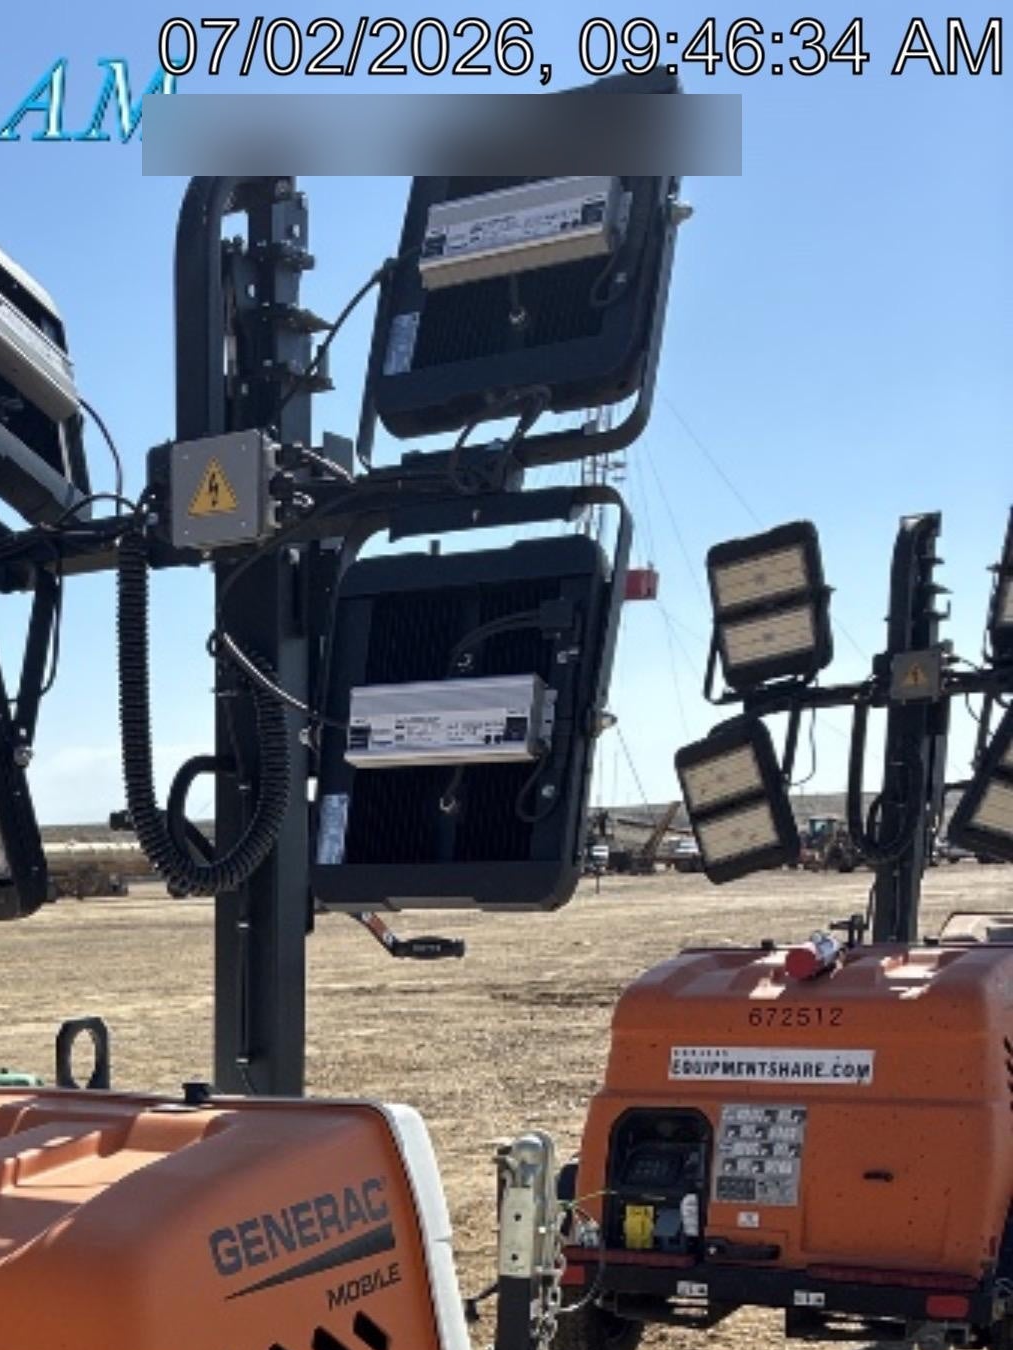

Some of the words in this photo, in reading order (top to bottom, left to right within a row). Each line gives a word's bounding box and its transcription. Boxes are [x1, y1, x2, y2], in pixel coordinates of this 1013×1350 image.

[748, 1007, 843, 1027] 672512
[209, 1177, 389, 1276] GENERAC
[326, 1262, 402, 1312] MOBILE
